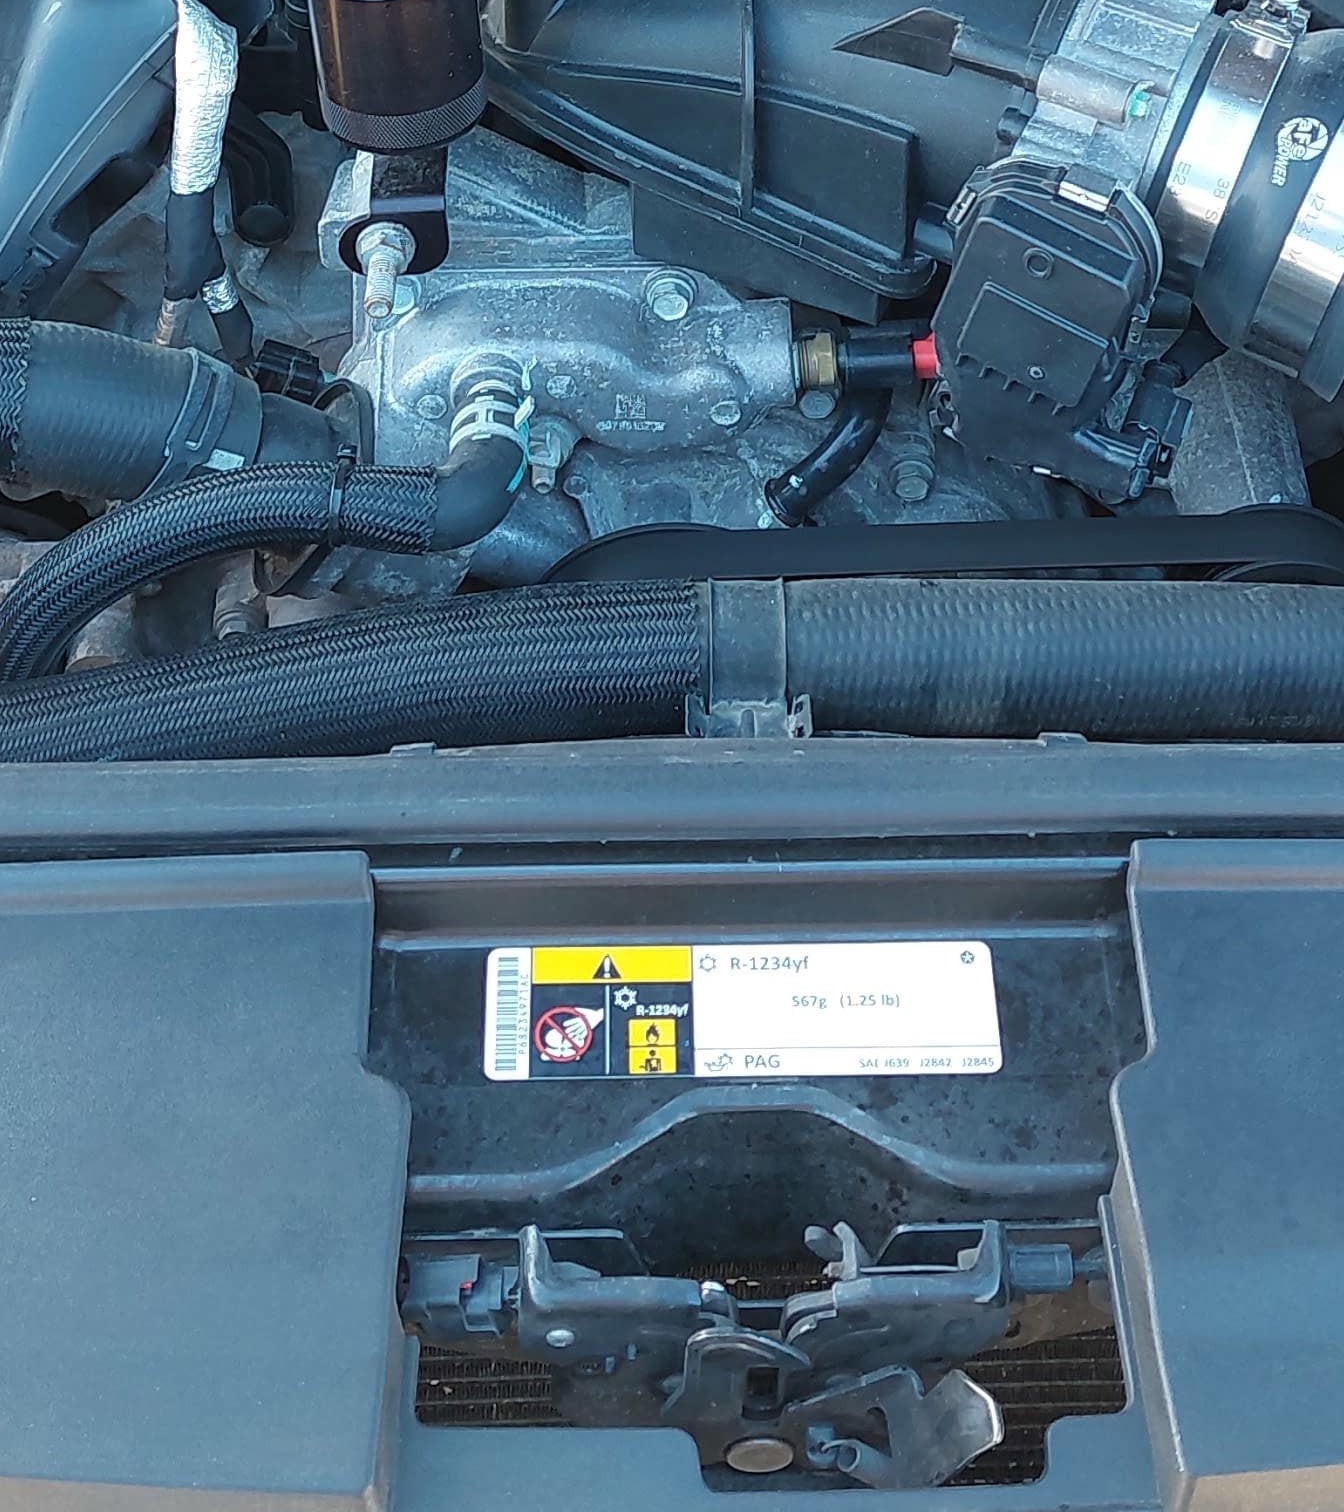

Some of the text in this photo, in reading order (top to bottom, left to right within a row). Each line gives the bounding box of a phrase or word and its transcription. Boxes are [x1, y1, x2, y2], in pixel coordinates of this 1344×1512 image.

[1271, 136, 1293, 187] POWER
[730, 955, 810, 973] R-1234yf
[791, 993, 901, 1009] 567g (1.25 lb)
[635, 1003, 690, 1018] R-1234yf
[744, 1054, 781, 1069] PAG
[960, 1056, 995, 1067] J2845
